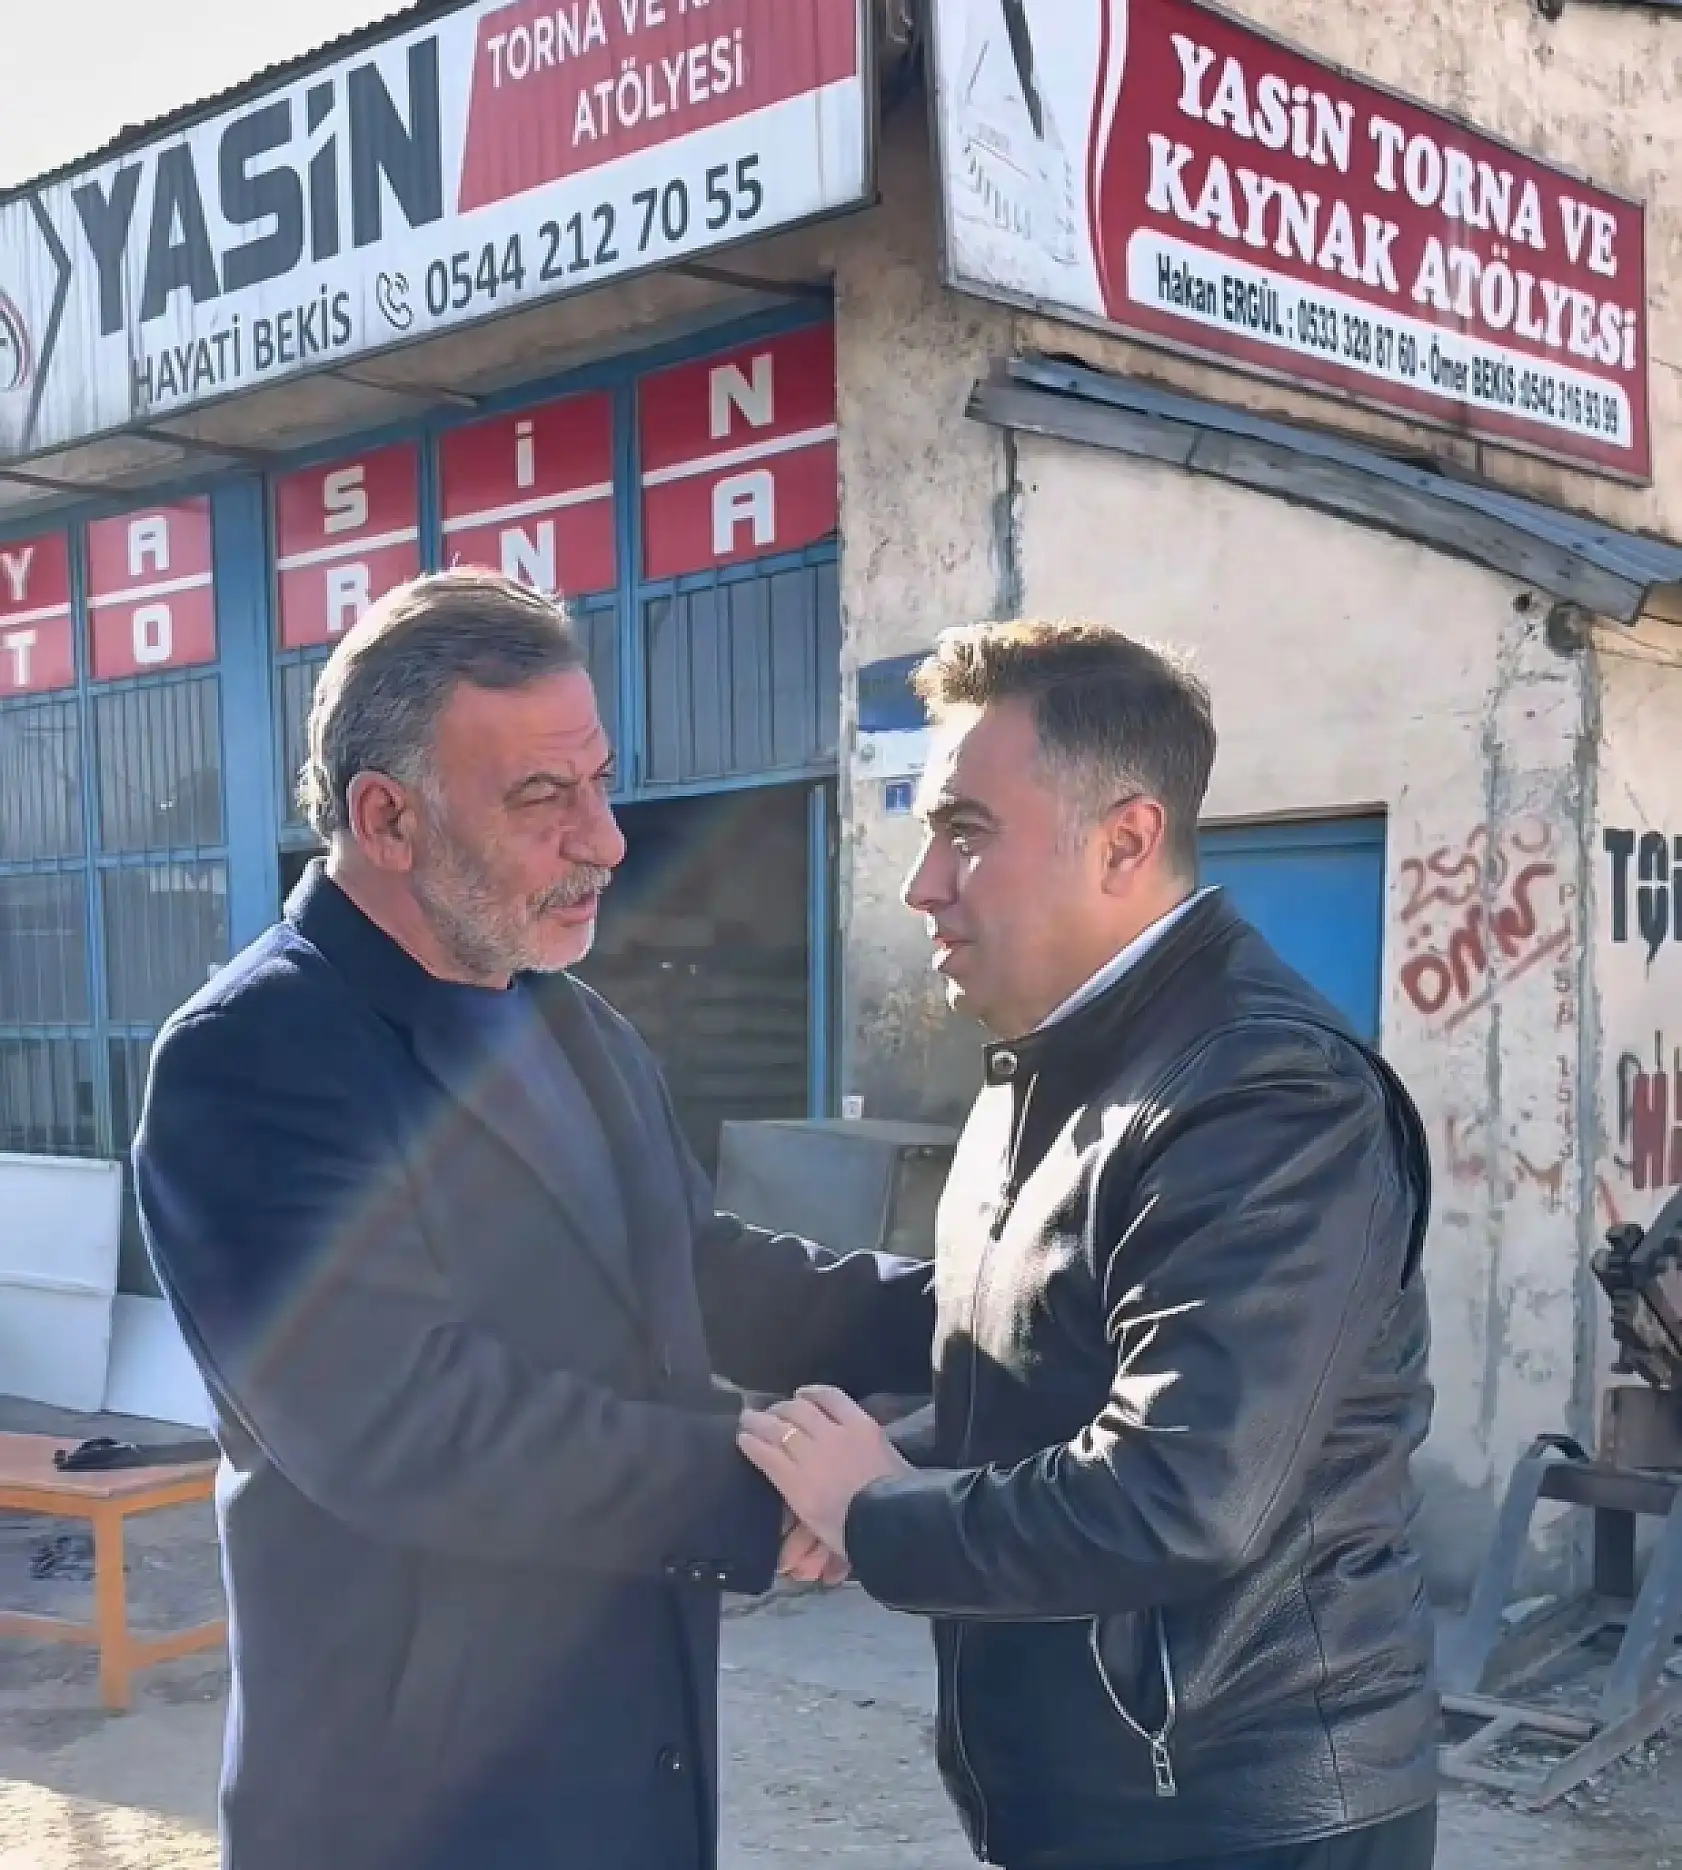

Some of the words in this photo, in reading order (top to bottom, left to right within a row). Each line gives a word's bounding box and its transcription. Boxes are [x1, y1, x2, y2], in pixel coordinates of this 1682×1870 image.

[487, 0, 607, 88] TORNA
[426, 234, 522, 316] 0544
[539, 203, 619, 281] 212
[633, 179, 688, 251] 70
[707, 154, 762, 230] 55
[1147, 132, 1400, 294] KAYNAK
[1369, 114, 1546, 250] TORNA
[1558, 195, 1617, 279] VE
[1156, 252, 1217, 316] Hakan
[1298, 298, 1338, 352] 0533
